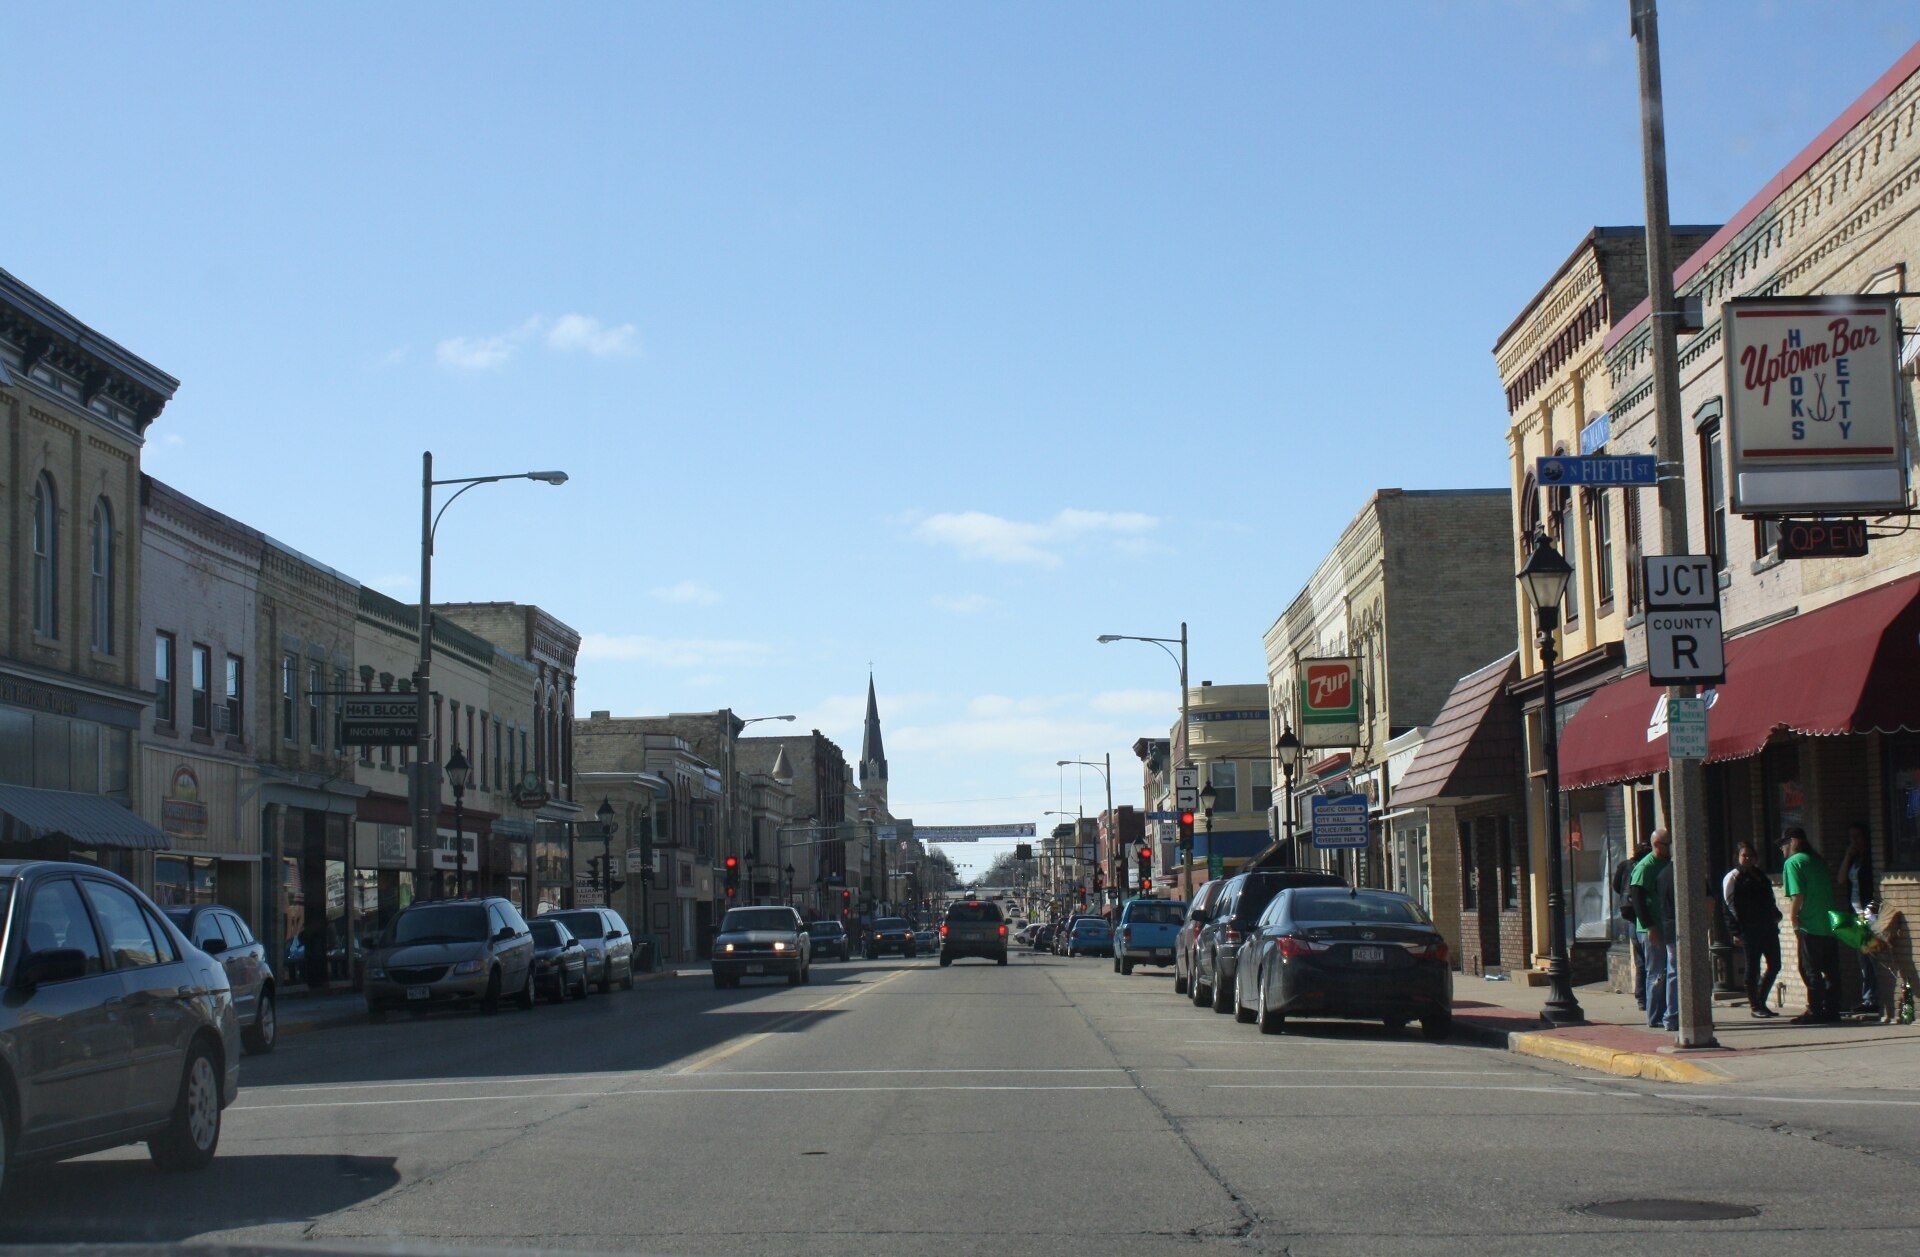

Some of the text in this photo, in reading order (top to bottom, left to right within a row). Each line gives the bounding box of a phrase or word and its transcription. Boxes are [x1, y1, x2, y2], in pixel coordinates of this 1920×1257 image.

[1740, 318, 1881, 406] Uptown Bar
[1569, 460, 1650, 481] N FIFTH ST
[1791, 524, 1865, 550] OPEN
[1654, 564, 1708, 596] JCT
[1653, 618, 1713, 630] COUNTY
[1672, 635, 1699, 670] R
[346, 704, 416, 716] H&R BLOCK
[1670, 703, 1679, 718] 2
[350, 727, 413, 737] INCOME TAX
[1183, 776, 1190, 785] R
[1316, 826, 1352, 834] POLICE/FIRE
